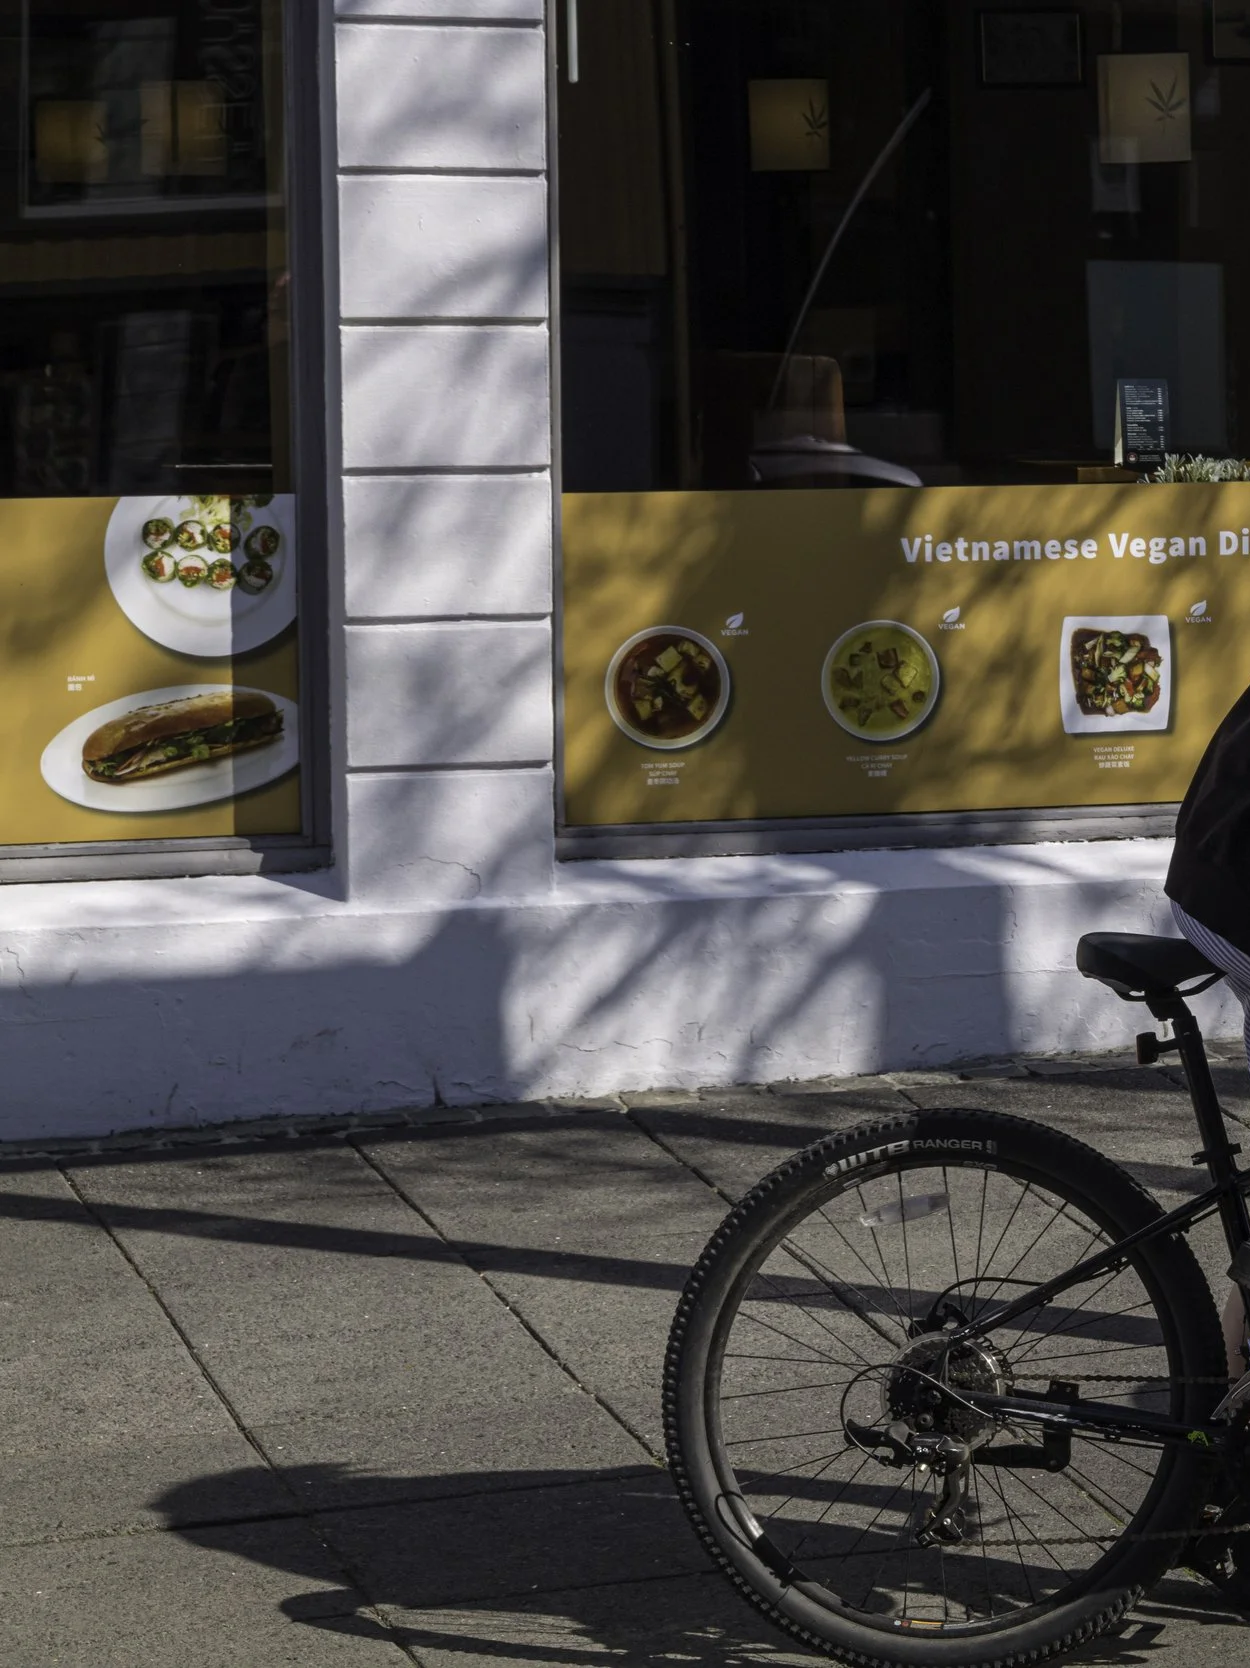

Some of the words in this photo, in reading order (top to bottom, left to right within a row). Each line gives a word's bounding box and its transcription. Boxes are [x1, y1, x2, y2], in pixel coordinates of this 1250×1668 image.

[900, 534, 1097, 563] Vietnamese
[1108, 531, 1207, 564] Vegan
[912, 1139, 983, 1150] RANGER
